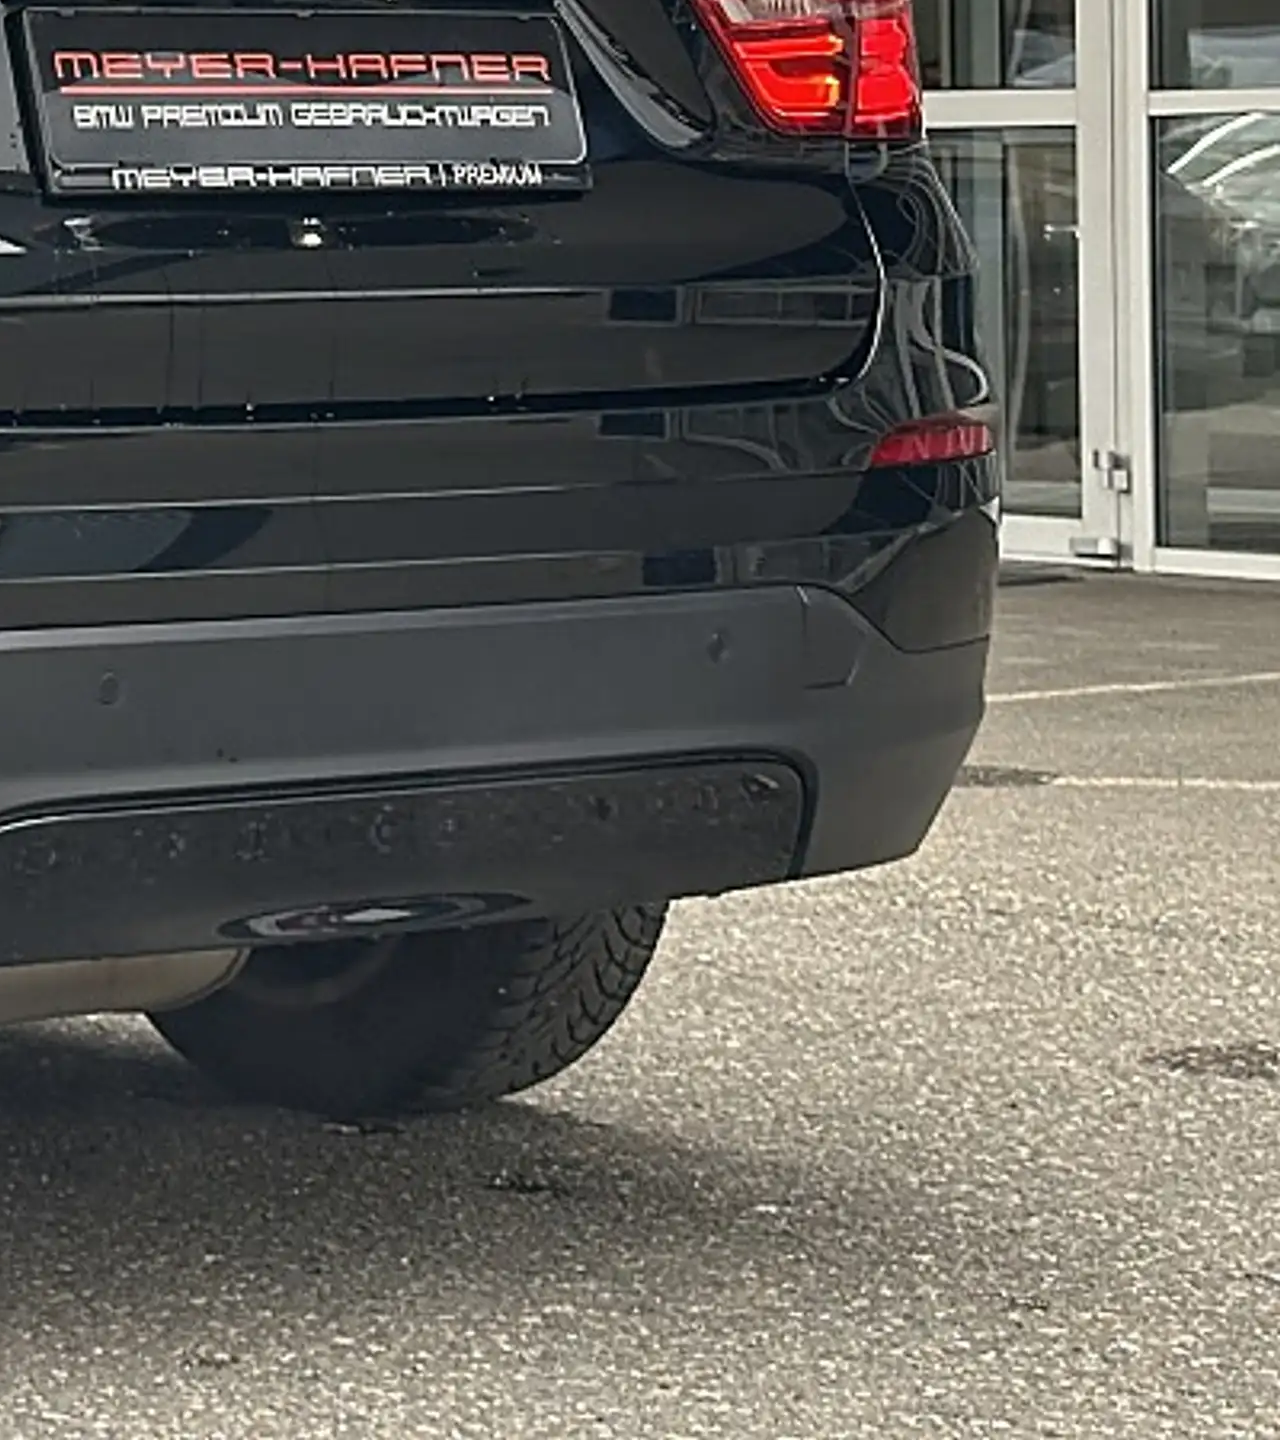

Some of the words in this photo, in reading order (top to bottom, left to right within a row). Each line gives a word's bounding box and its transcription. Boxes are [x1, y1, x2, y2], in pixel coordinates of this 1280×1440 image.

[54, 52, 551, 82] MEYER-HAFNER
[73, 105, 134, 128] BMW
[112, 166, 431, 190] MEYER-HAFNER
